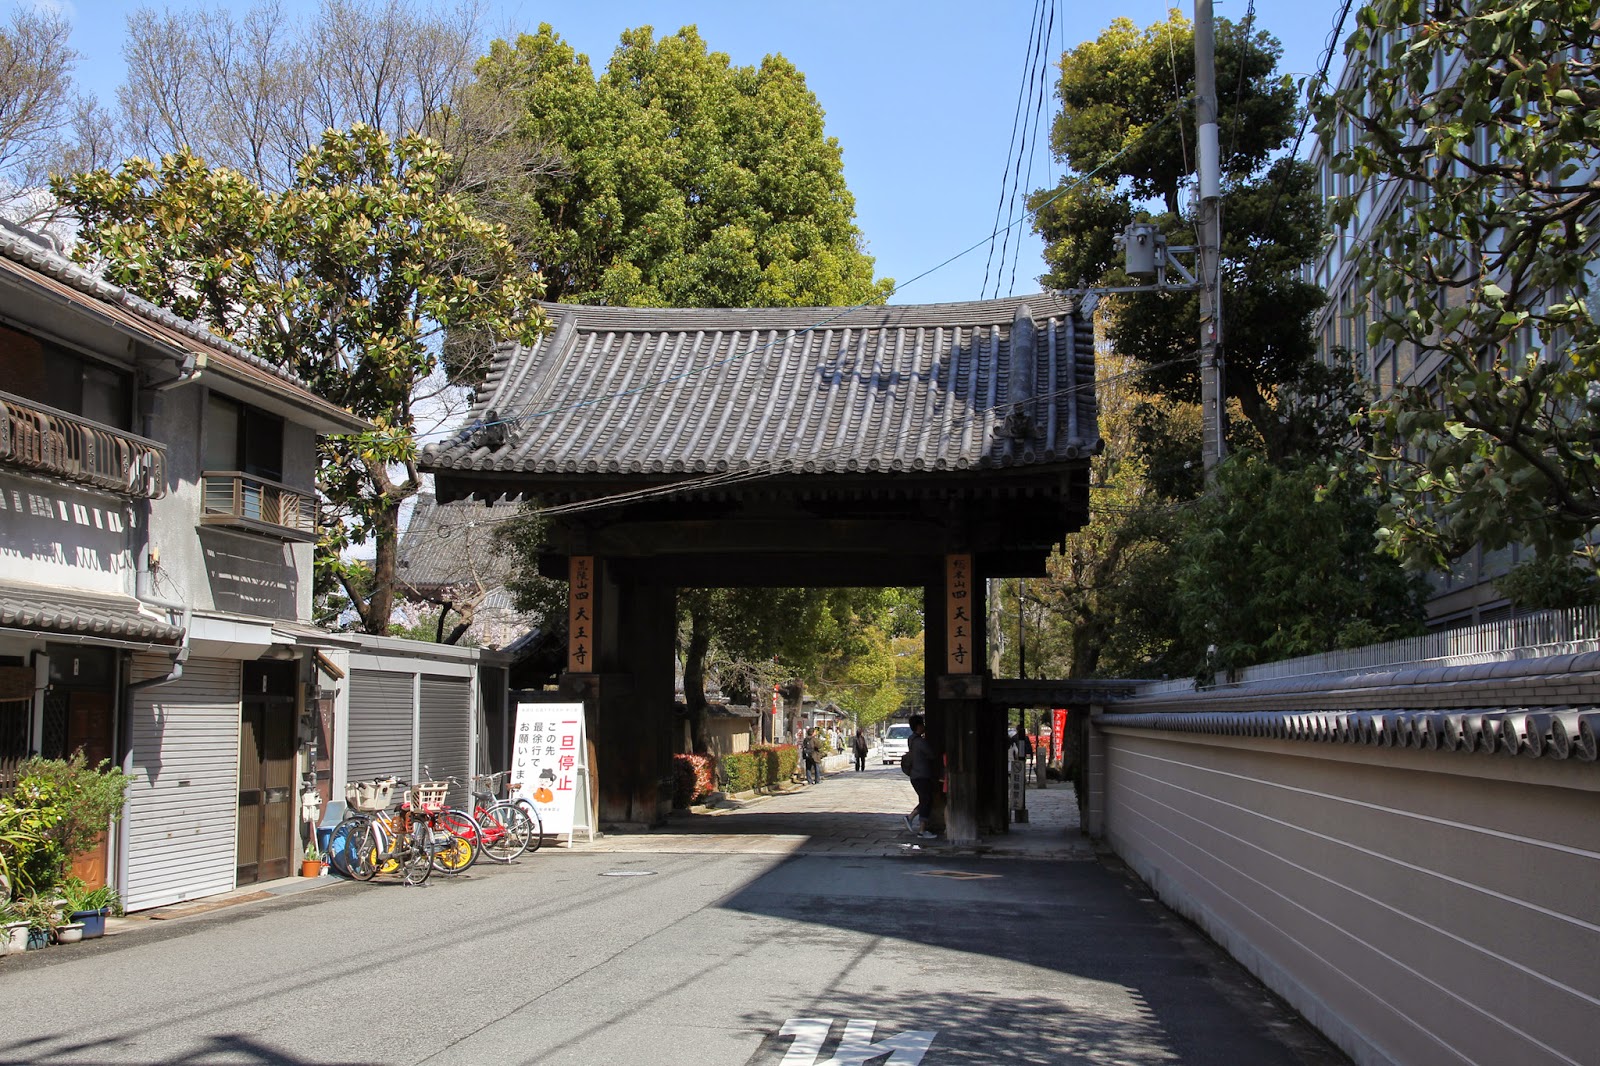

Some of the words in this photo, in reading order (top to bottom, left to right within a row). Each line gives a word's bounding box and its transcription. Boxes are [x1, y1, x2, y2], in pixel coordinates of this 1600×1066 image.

[545, 722, 556, 756] この先
[557, 721, 577, 790] 一旦停止
